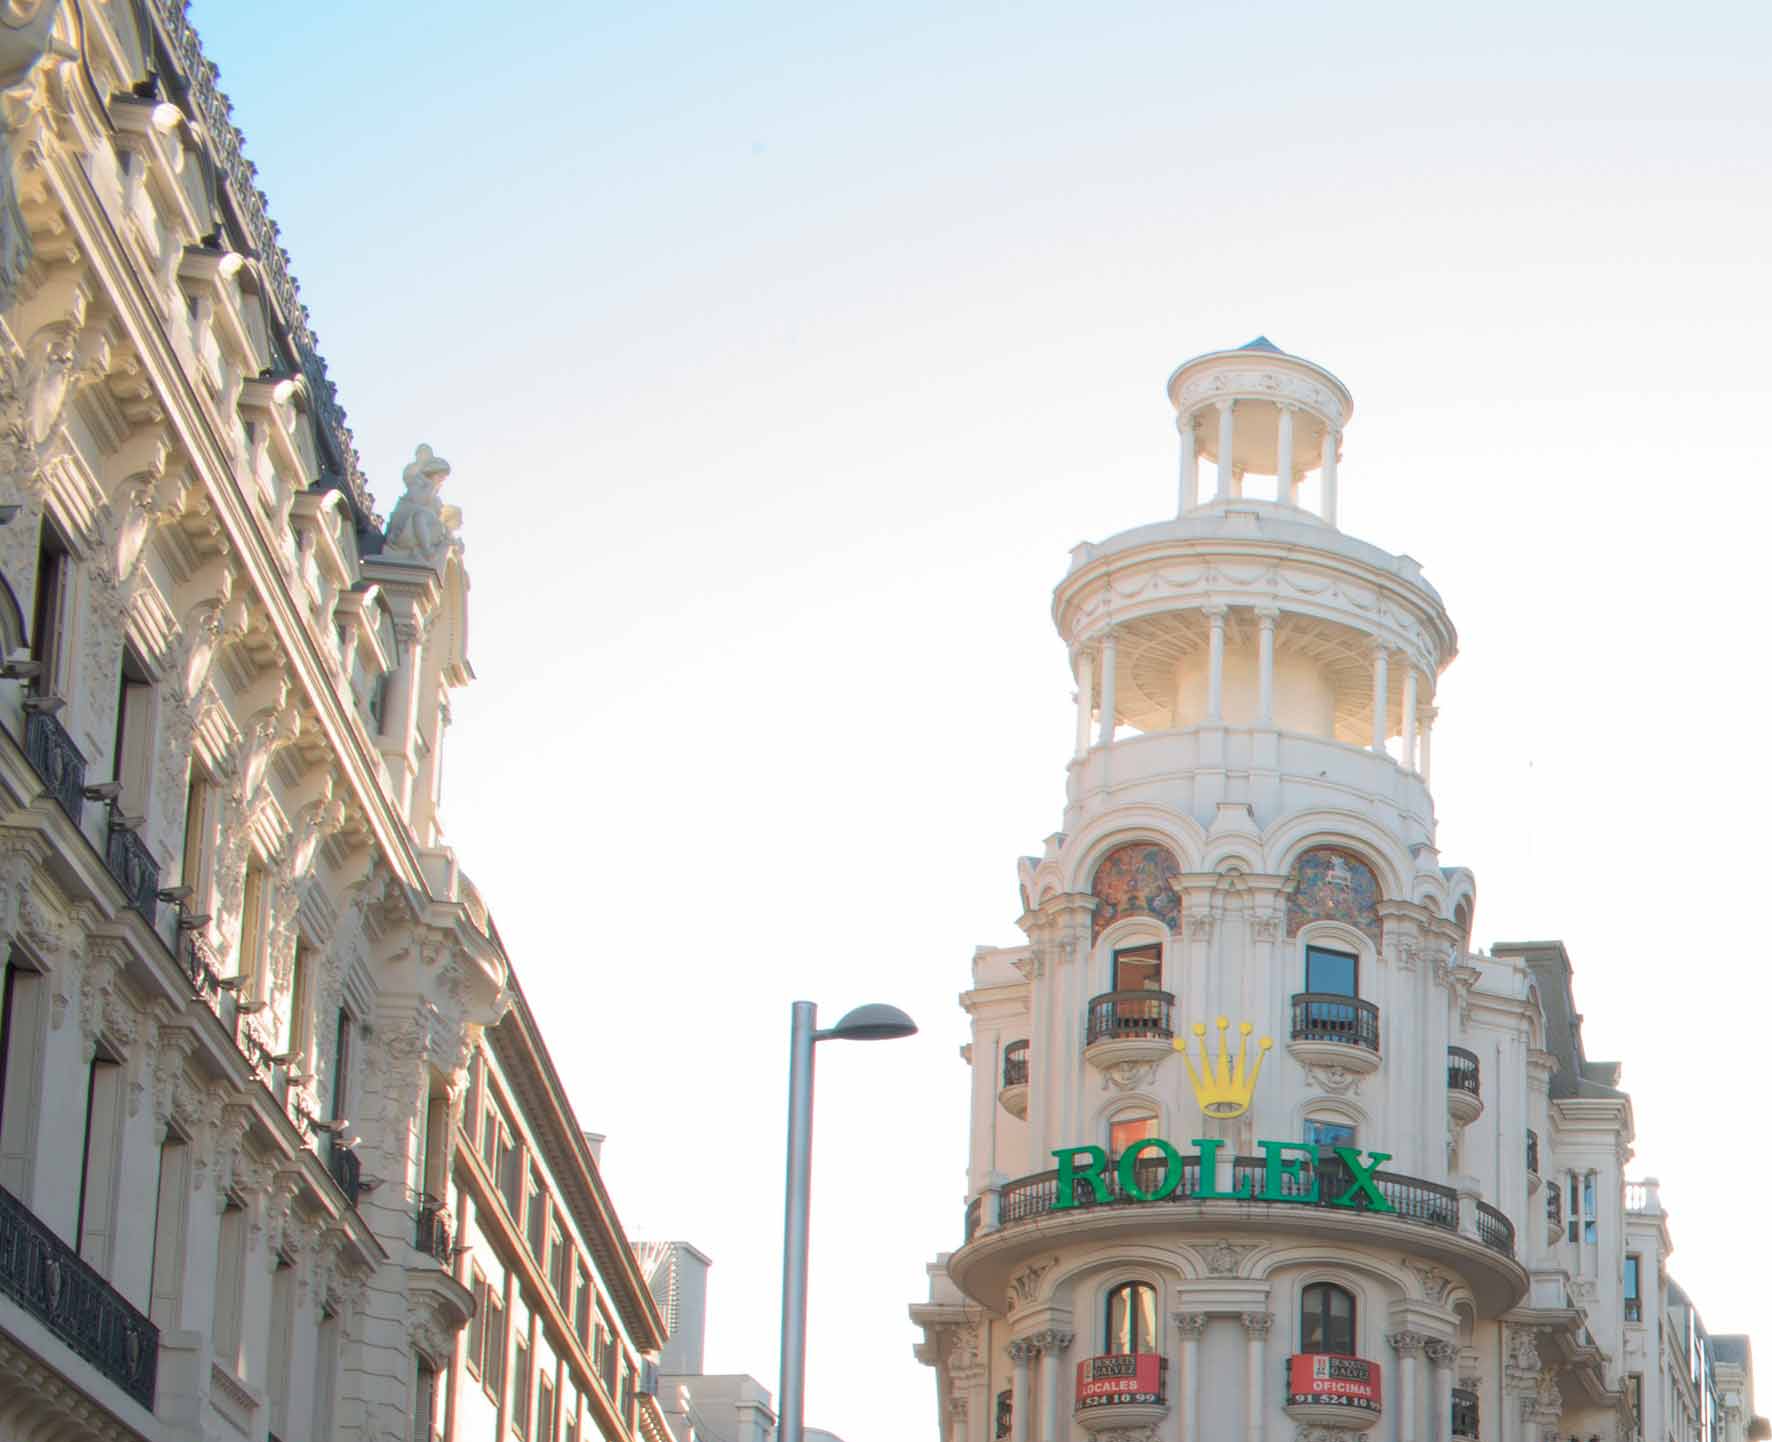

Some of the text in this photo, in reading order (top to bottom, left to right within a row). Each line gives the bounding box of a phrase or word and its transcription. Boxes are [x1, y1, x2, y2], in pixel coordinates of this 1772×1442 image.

[1051, 1138, 1398, 1213] ROLEX
[1082, 1380, 1138, 1395] LOCALES
[1313, 1380, 1372, 1396] OFICINAS
[1113, 1393, 1131, 1404] 10
[1135, 1392, 1155, 1402] 99
[1295, 1394, 1313, 1403] 91
[1319, 1394, 1348, 1405] 524
